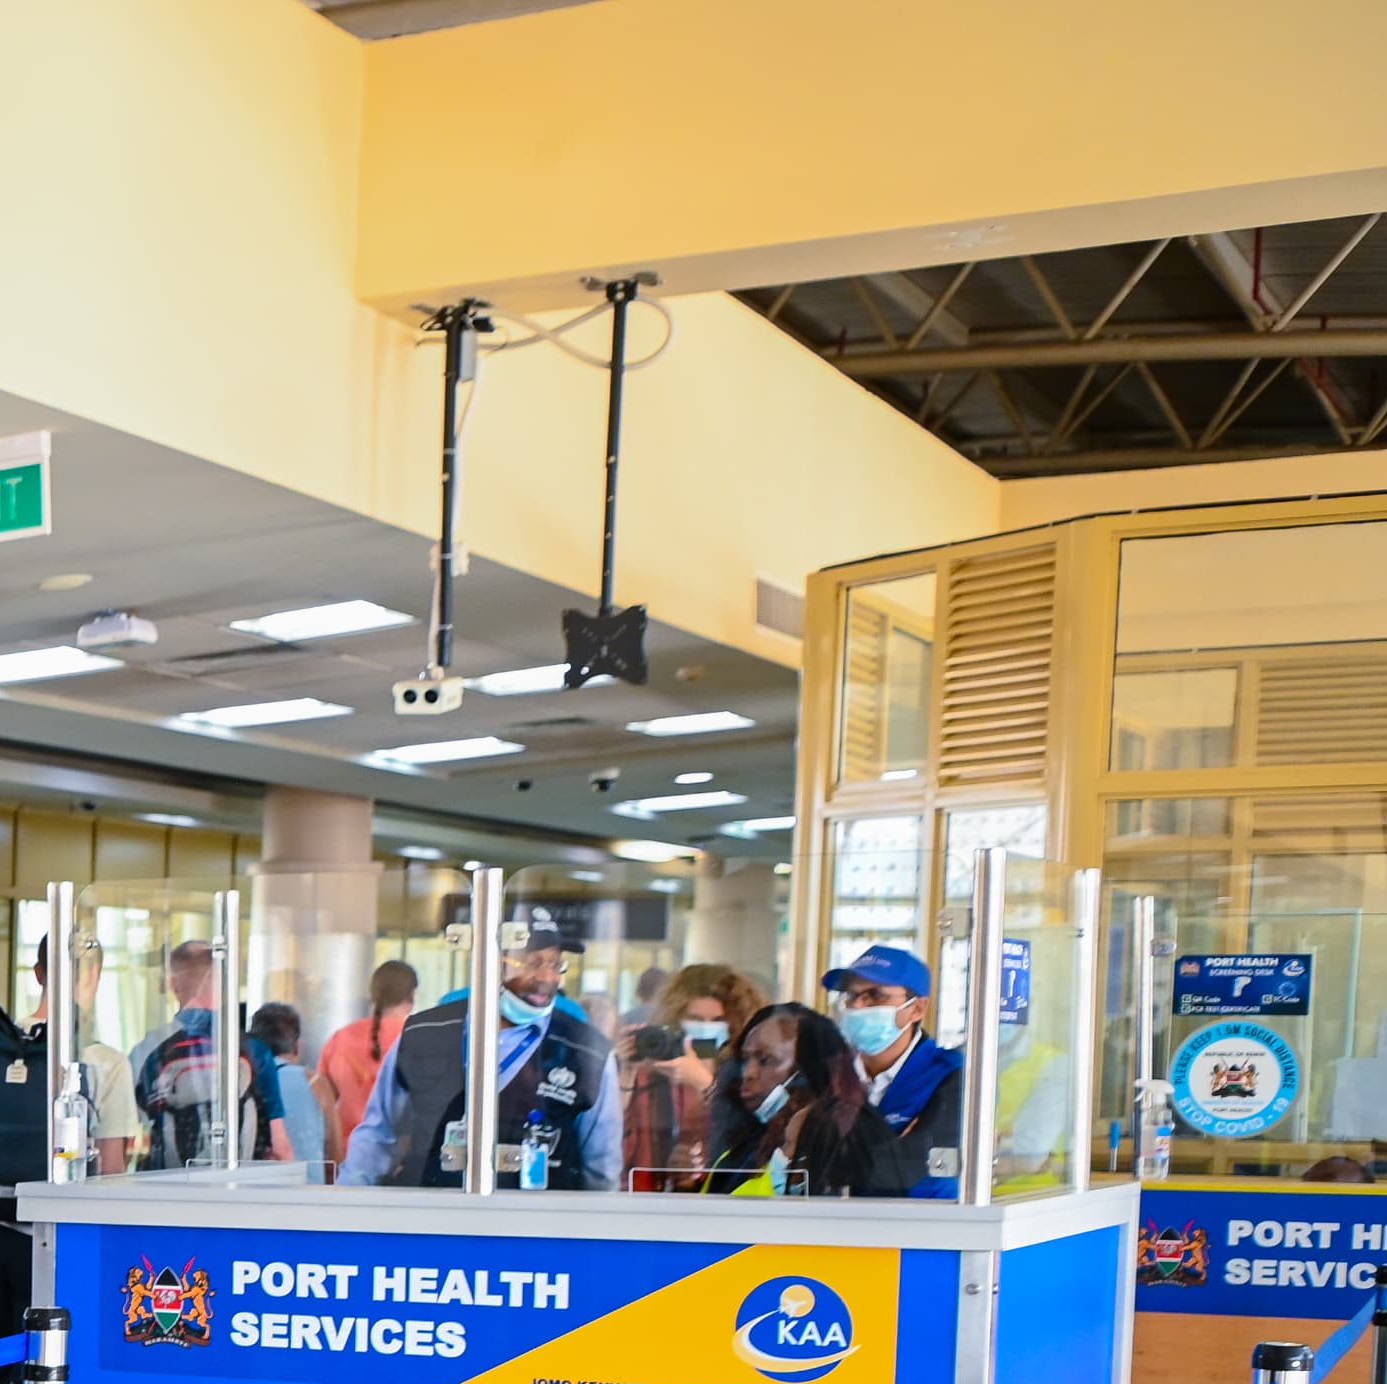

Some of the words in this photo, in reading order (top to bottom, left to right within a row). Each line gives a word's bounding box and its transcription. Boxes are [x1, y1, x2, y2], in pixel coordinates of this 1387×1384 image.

[1205, 957, 1236, 967] PORT
[1237, 957, 1280, 968] HEALTH
[1192, 1031, 1213, 1053] KEEP
[1243, 1024, 1277, 1048] SOCIAL
[1274, 1045, 1296, 1089] DISTANCE
[1178, 1096, 1212, 1127] STOP
[1214, 1117, 1265, 1135] COVID
[1228, 1219, 1340, 1249] PORT
[232, 1261, 360, 1300] PORT
[372, 1266, 570, 1309] HEALTH
[1225, 1258, 1378, 1290] SERVIC
[230, 1311, 468, 1358] SERVICES
[776, 1319, 848, 1348] KAA
